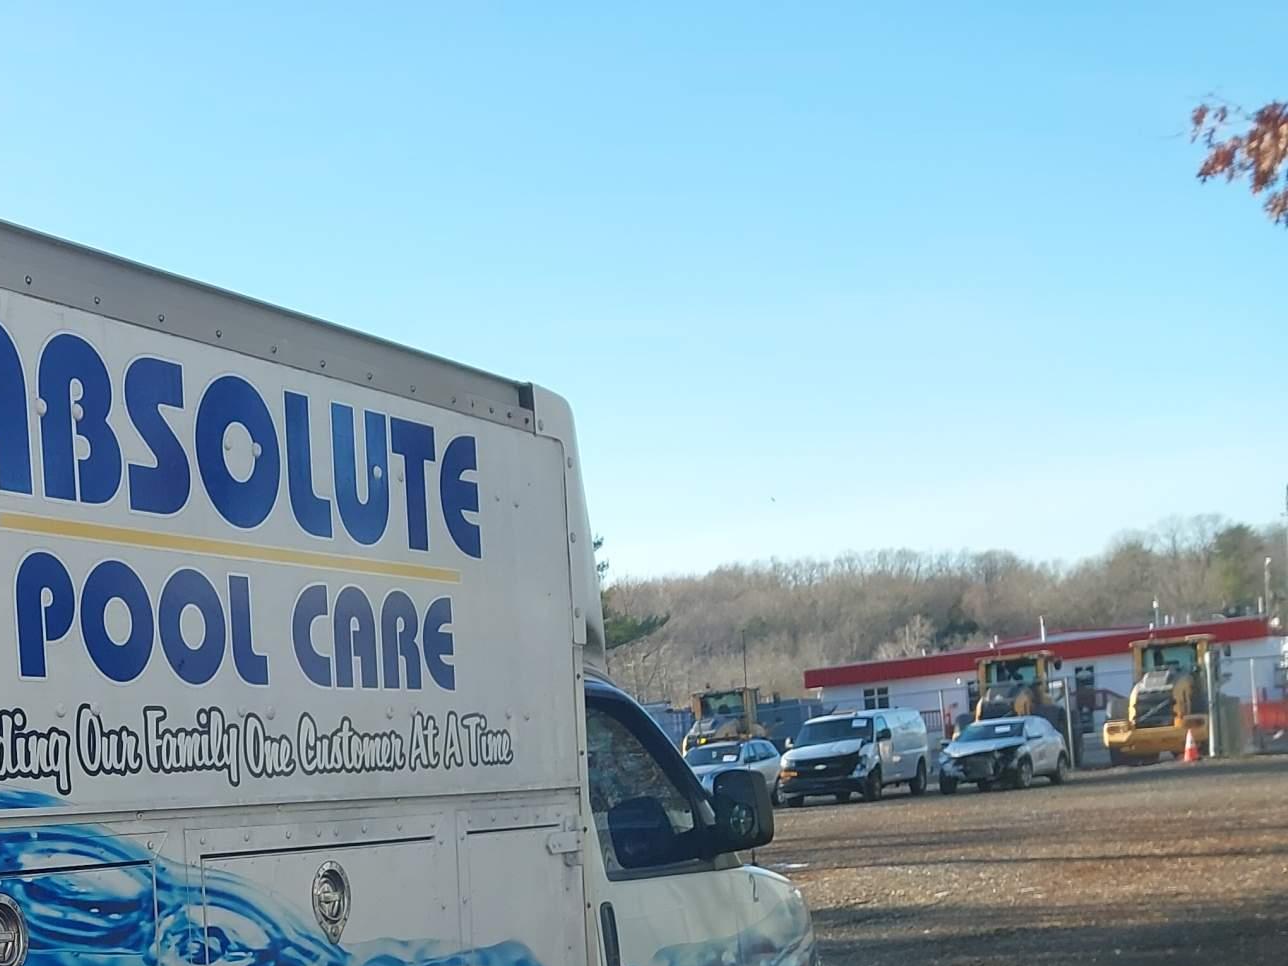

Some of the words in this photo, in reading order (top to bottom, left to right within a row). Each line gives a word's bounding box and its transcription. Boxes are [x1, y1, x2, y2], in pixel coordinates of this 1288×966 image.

[15, 552, 269, 685] POOL
[292, 584, 456, 692] CARE
[76, 703, 142, 777] Our
[143, 705, 240, 787] Family
[244, 712, 295, 778] One
[297, 712, 405, 773] Customer
[409, 711, 439, 771] At
[443, 711, 463, 769] A
[461, 713, 513, 766] Time
